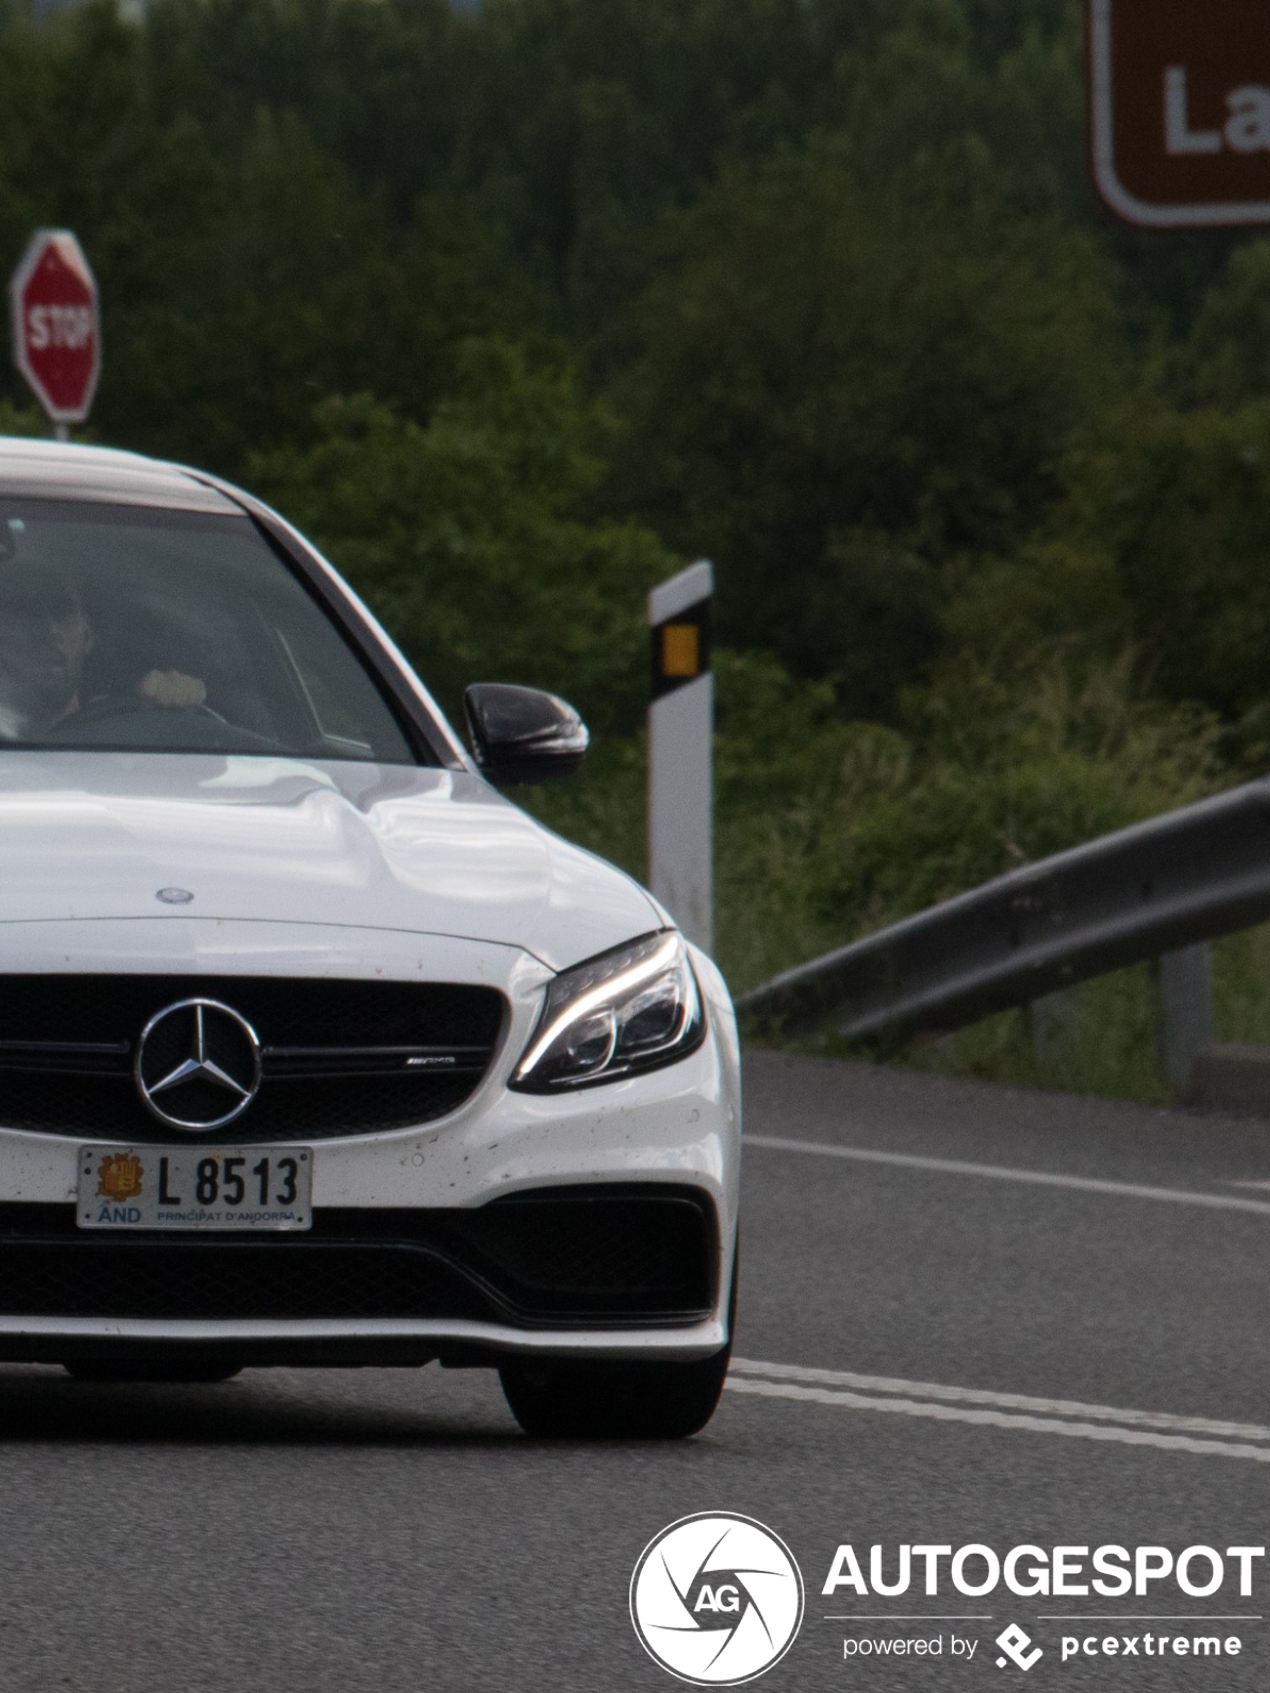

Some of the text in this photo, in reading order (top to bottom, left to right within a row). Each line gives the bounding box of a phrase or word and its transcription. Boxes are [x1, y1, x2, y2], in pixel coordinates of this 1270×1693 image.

[29, 305, 91, 350] STOP
[159, 1157, 299, 1206] L 8513
[98, 1207, 142, 1223] AND
[157, 1211, 296, 1222] PRINCIPAT D'ANDORRA
